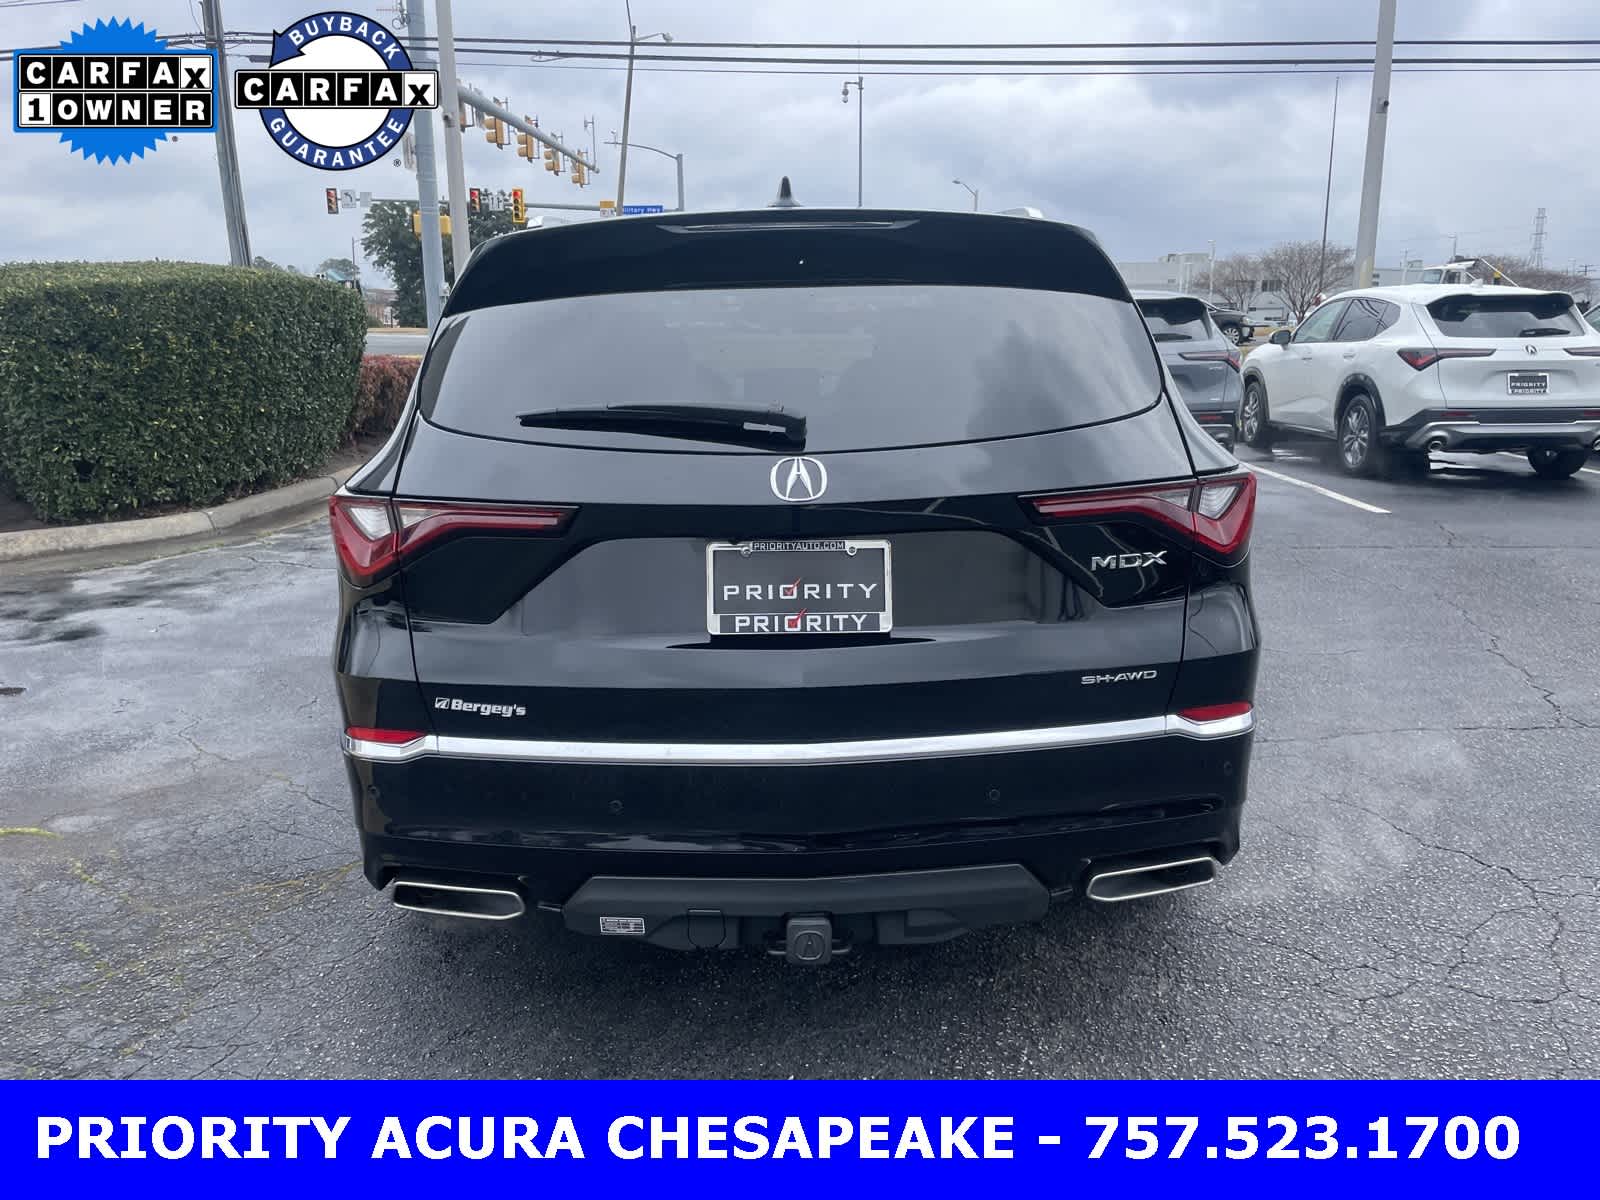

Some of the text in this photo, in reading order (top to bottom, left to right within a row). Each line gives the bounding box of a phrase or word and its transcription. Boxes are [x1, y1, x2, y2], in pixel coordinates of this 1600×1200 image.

[753, 541, 846, 551] PRIORITYAUTO.COM
[1091, 550, 1168, 571] MDX
[723, 582, 878, 601] PRIORITY
[735, 613, 868, 632] PRIORITY
[1081, 670, 1158, 685] SH-AWD
[451, 698, 527, 718] Bergey's
